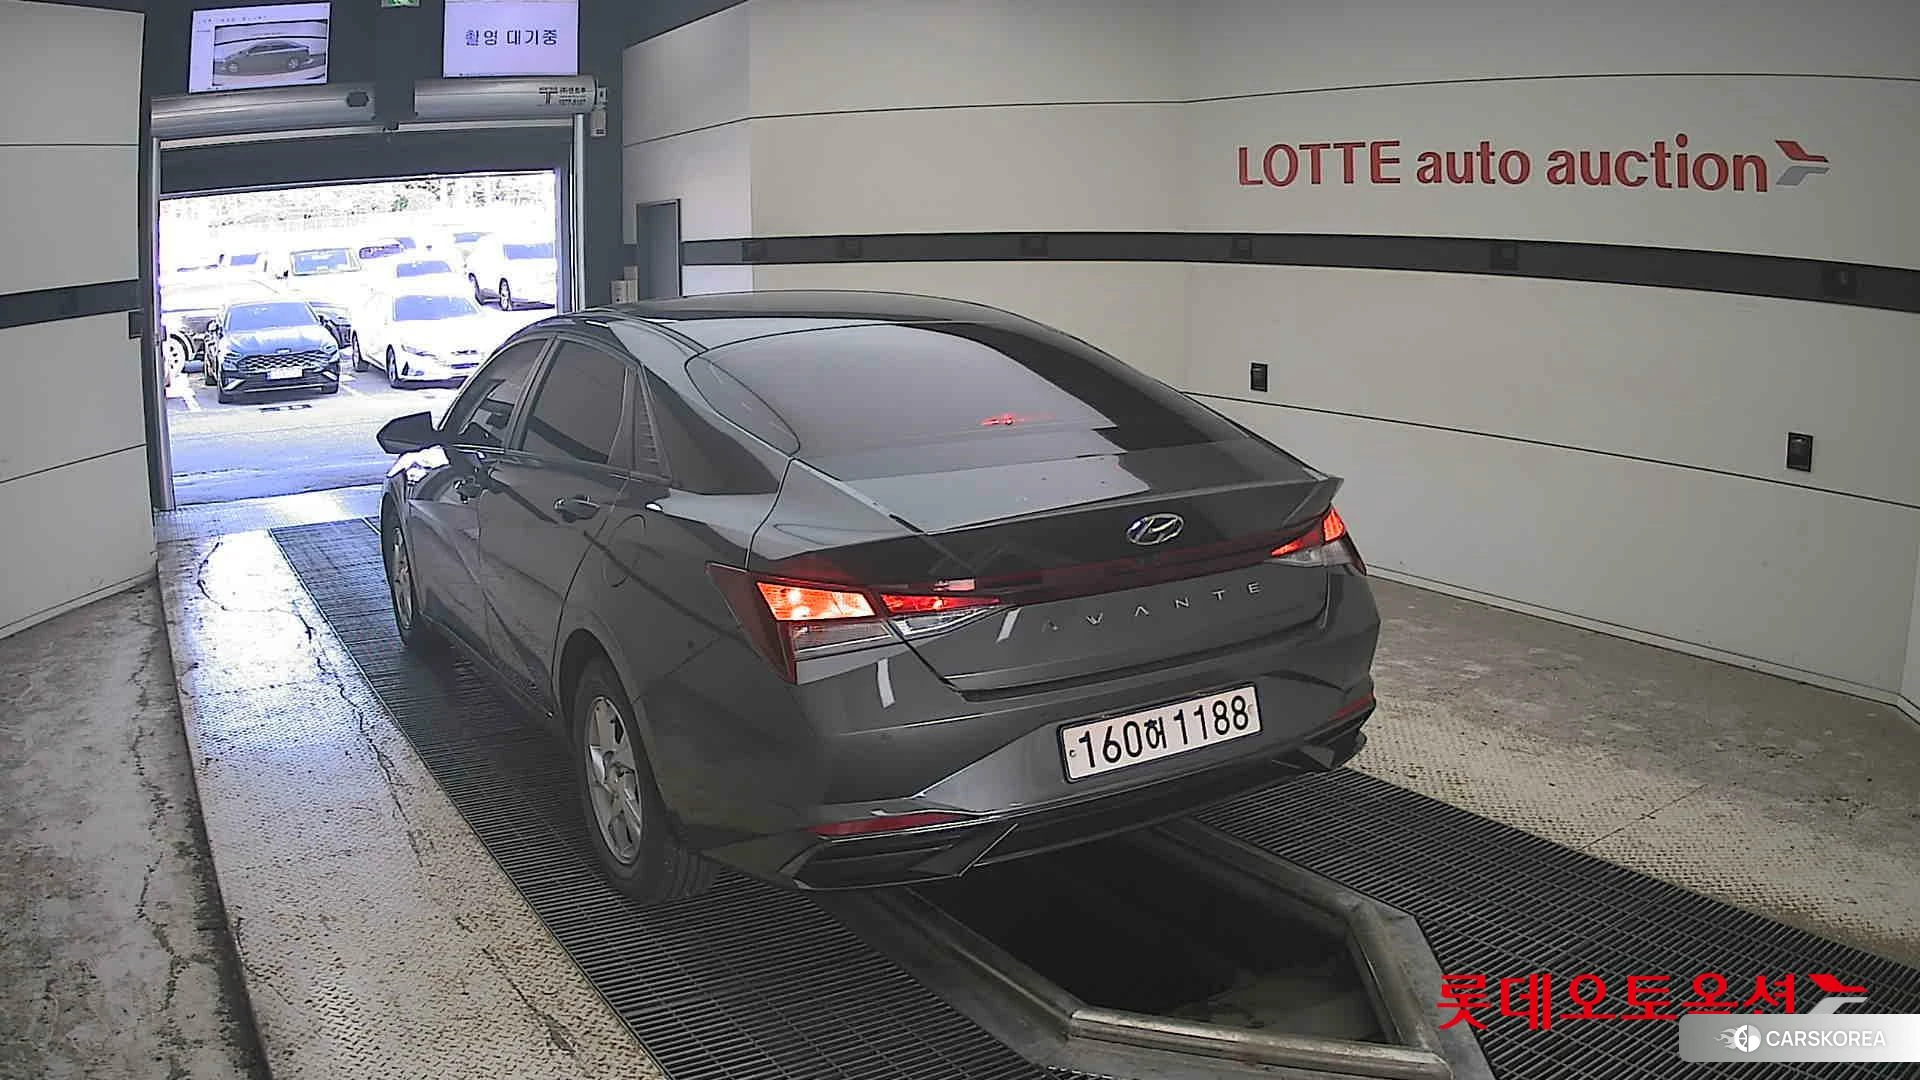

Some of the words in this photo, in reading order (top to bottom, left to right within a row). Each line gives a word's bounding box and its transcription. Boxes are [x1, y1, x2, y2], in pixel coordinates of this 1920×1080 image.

[506, 28, 558, 46] 대기중
[1239, 140, 1400, 187] LOTTE
[1416, 141, 1530, 184] auto
[1547, 133, 1768, 192] auction
